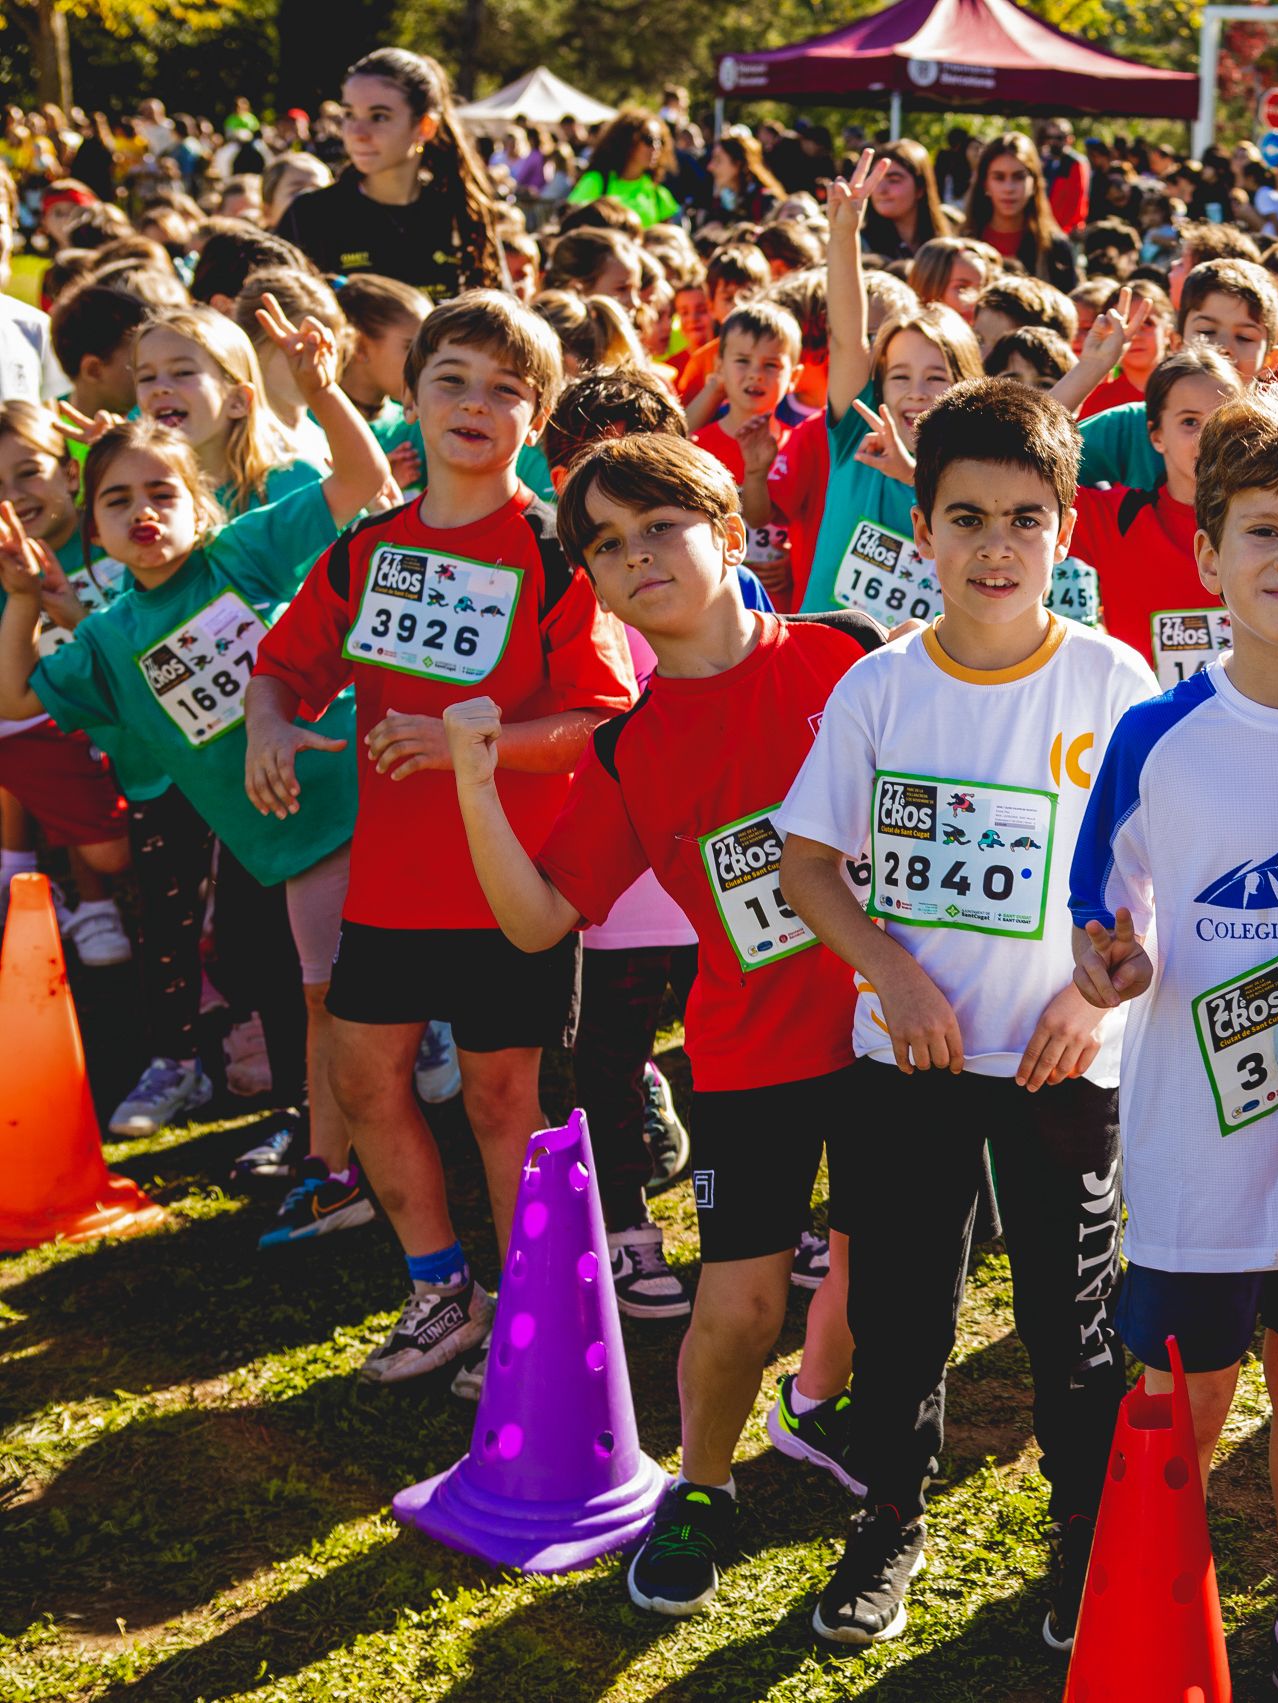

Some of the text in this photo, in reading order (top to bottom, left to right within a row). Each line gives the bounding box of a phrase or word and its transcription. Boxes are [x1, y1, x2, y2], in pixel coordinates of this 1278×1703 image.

[856, 540, 897, 566] CROS
[377, 568, 423, 593] CROS
[851, 568, 930, 619] 1680
[371, 608, 480, 657] 3926
[1161, 629, 1209, 645] CROS
[177, 650, 257, 720] 1687
[881, 803, 932, 830] CROS
[720, 839, 781, 880] CROS
[884, 851, 1014, 901] 2840
[1219, 1034, 1241, 1047] Ciutat
[1251, 1022, 1267, 1032] Sant
